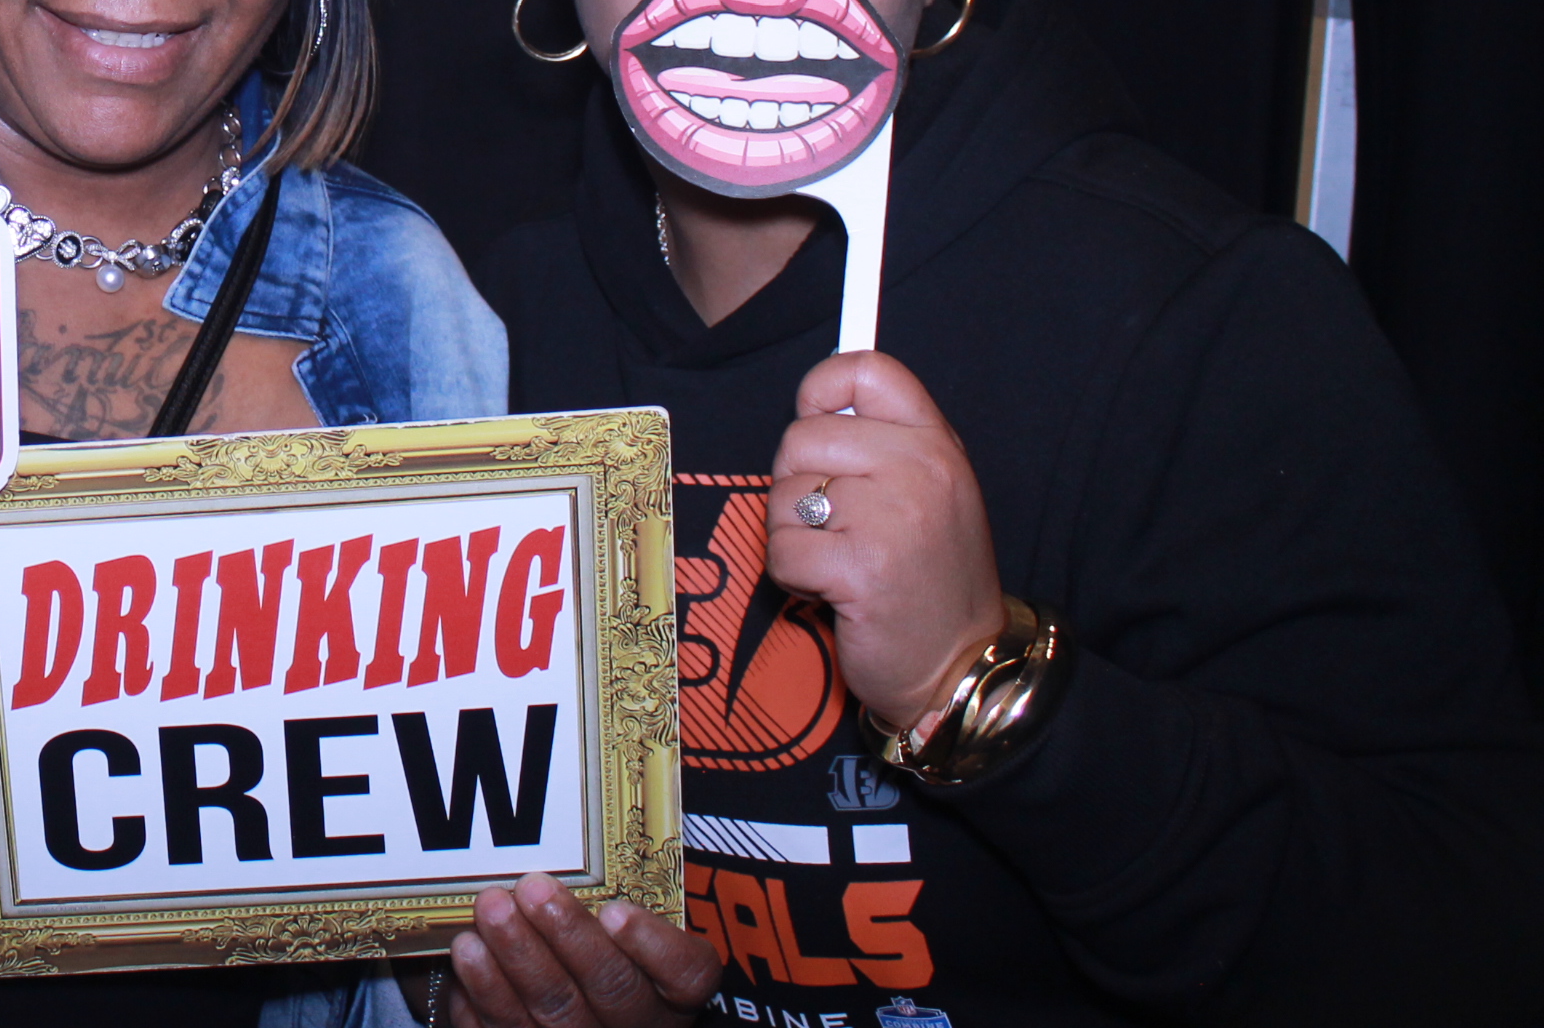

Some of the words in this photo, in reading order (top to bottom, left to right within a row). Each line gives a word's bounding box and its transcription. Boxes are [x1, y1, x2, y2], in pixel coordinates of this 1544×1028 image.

[11, 524, 566, 710] DRINKING
[37, 703, 558, 871] CREW
[684, 860, 936, 990] GALS
[706, 992, 853, 1028] MBINE
